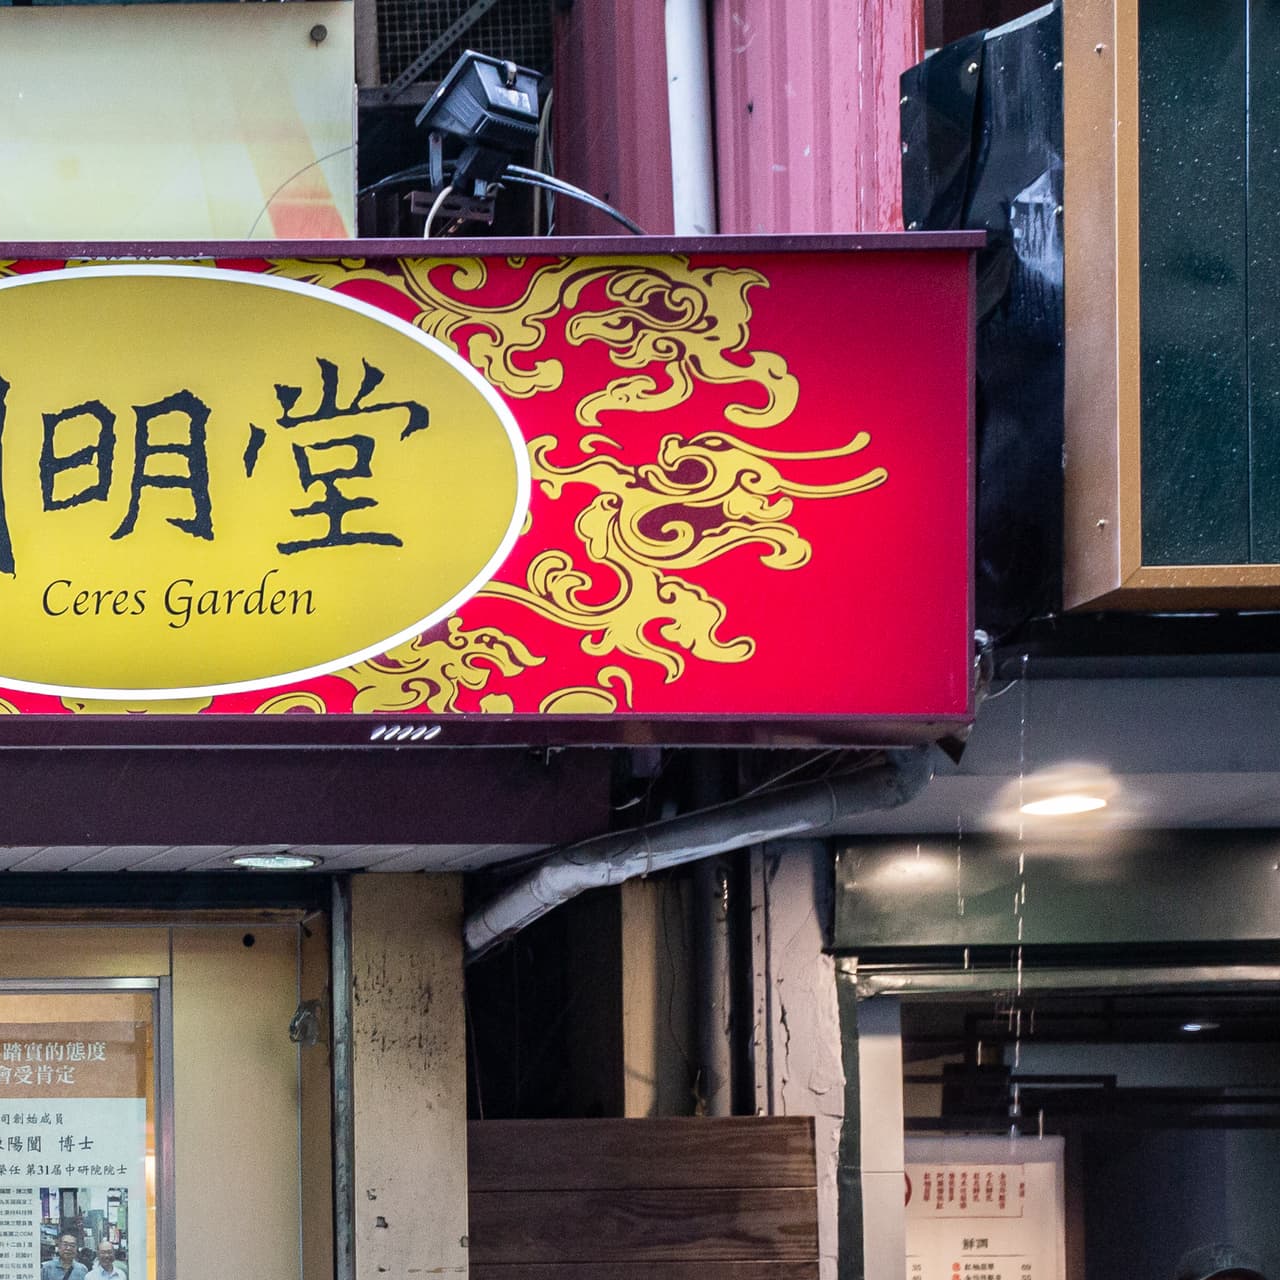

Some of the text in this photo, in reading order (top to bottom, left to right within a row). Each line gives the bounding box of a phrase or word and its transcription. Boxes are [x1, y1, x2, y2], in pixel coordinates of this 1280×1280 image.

[43, 569, 316, 629] Ceres Garden
[59, 1136, 94, 1151] 博士
